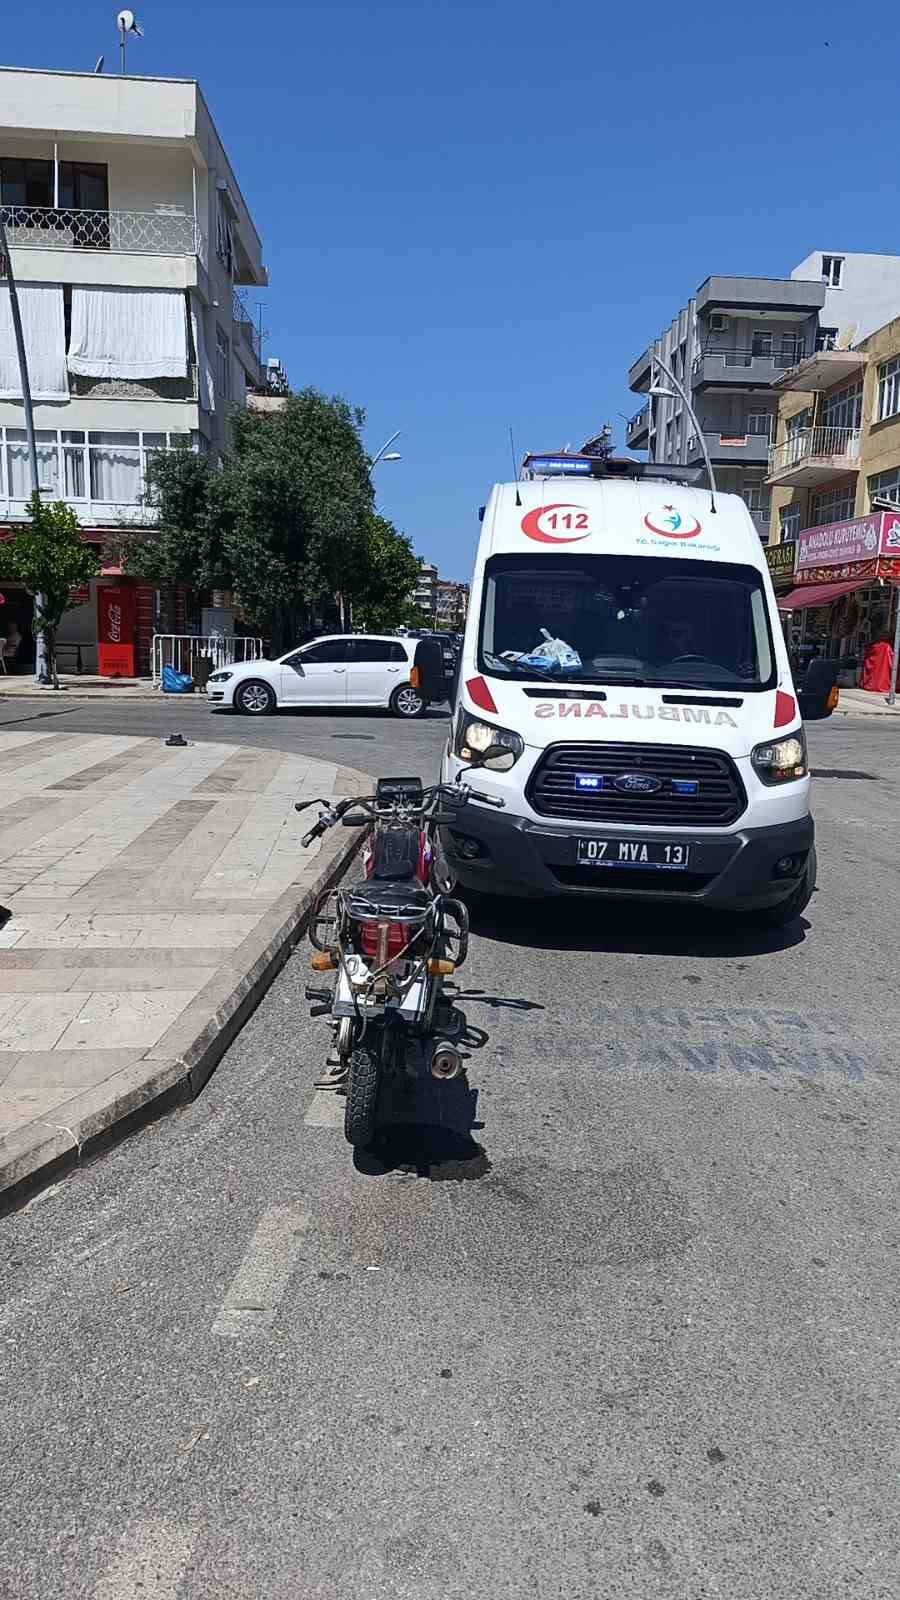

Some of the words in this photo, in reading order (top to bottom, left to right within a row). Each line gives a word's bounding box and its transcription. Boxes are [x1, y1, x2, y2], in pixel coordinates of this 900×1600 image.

[547, 513, 589, 530] 112
[587, 841, 608, 858] 07
[619, 843, 648, 861] MVA
[664, 846, 683, 863] 13
